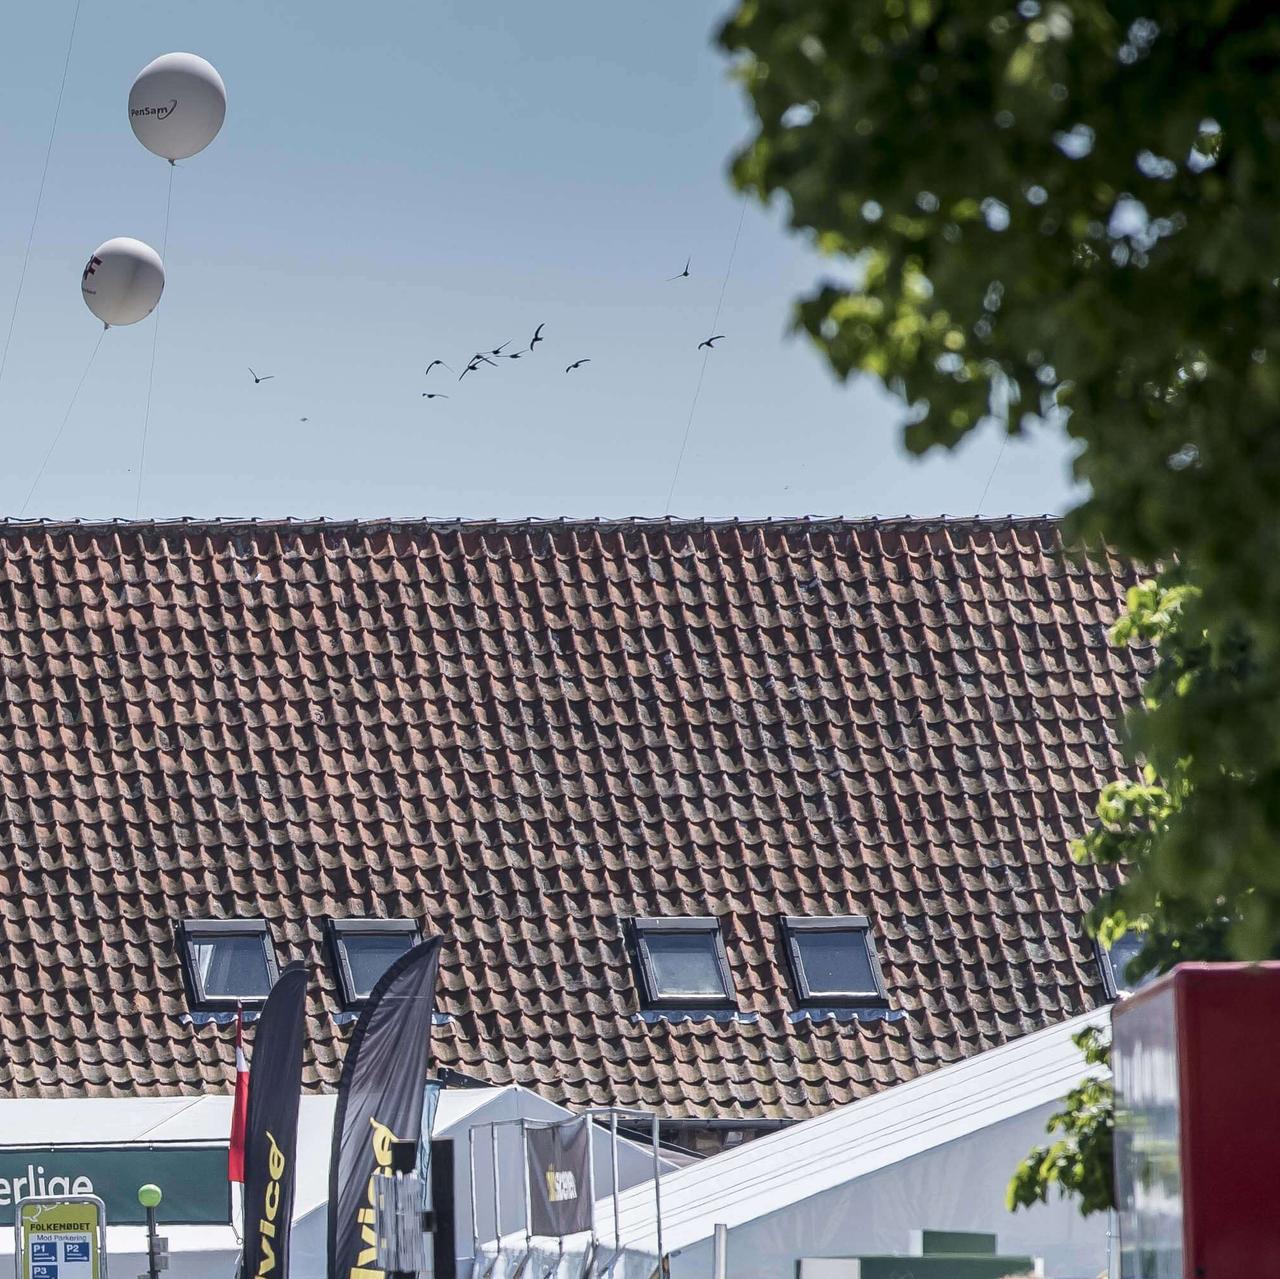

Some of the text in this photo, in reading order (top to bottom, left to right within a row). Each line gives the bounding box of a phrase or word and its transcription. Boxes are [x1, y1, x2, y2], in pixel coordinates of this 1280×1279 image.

[130, 106, 168, 117] PenSam
[29, 1222, 91, 1232] FOLKEMØDET
[33, 1244, 80, 1253] P1 P2
[33, 1266, 47, 1275] P3
